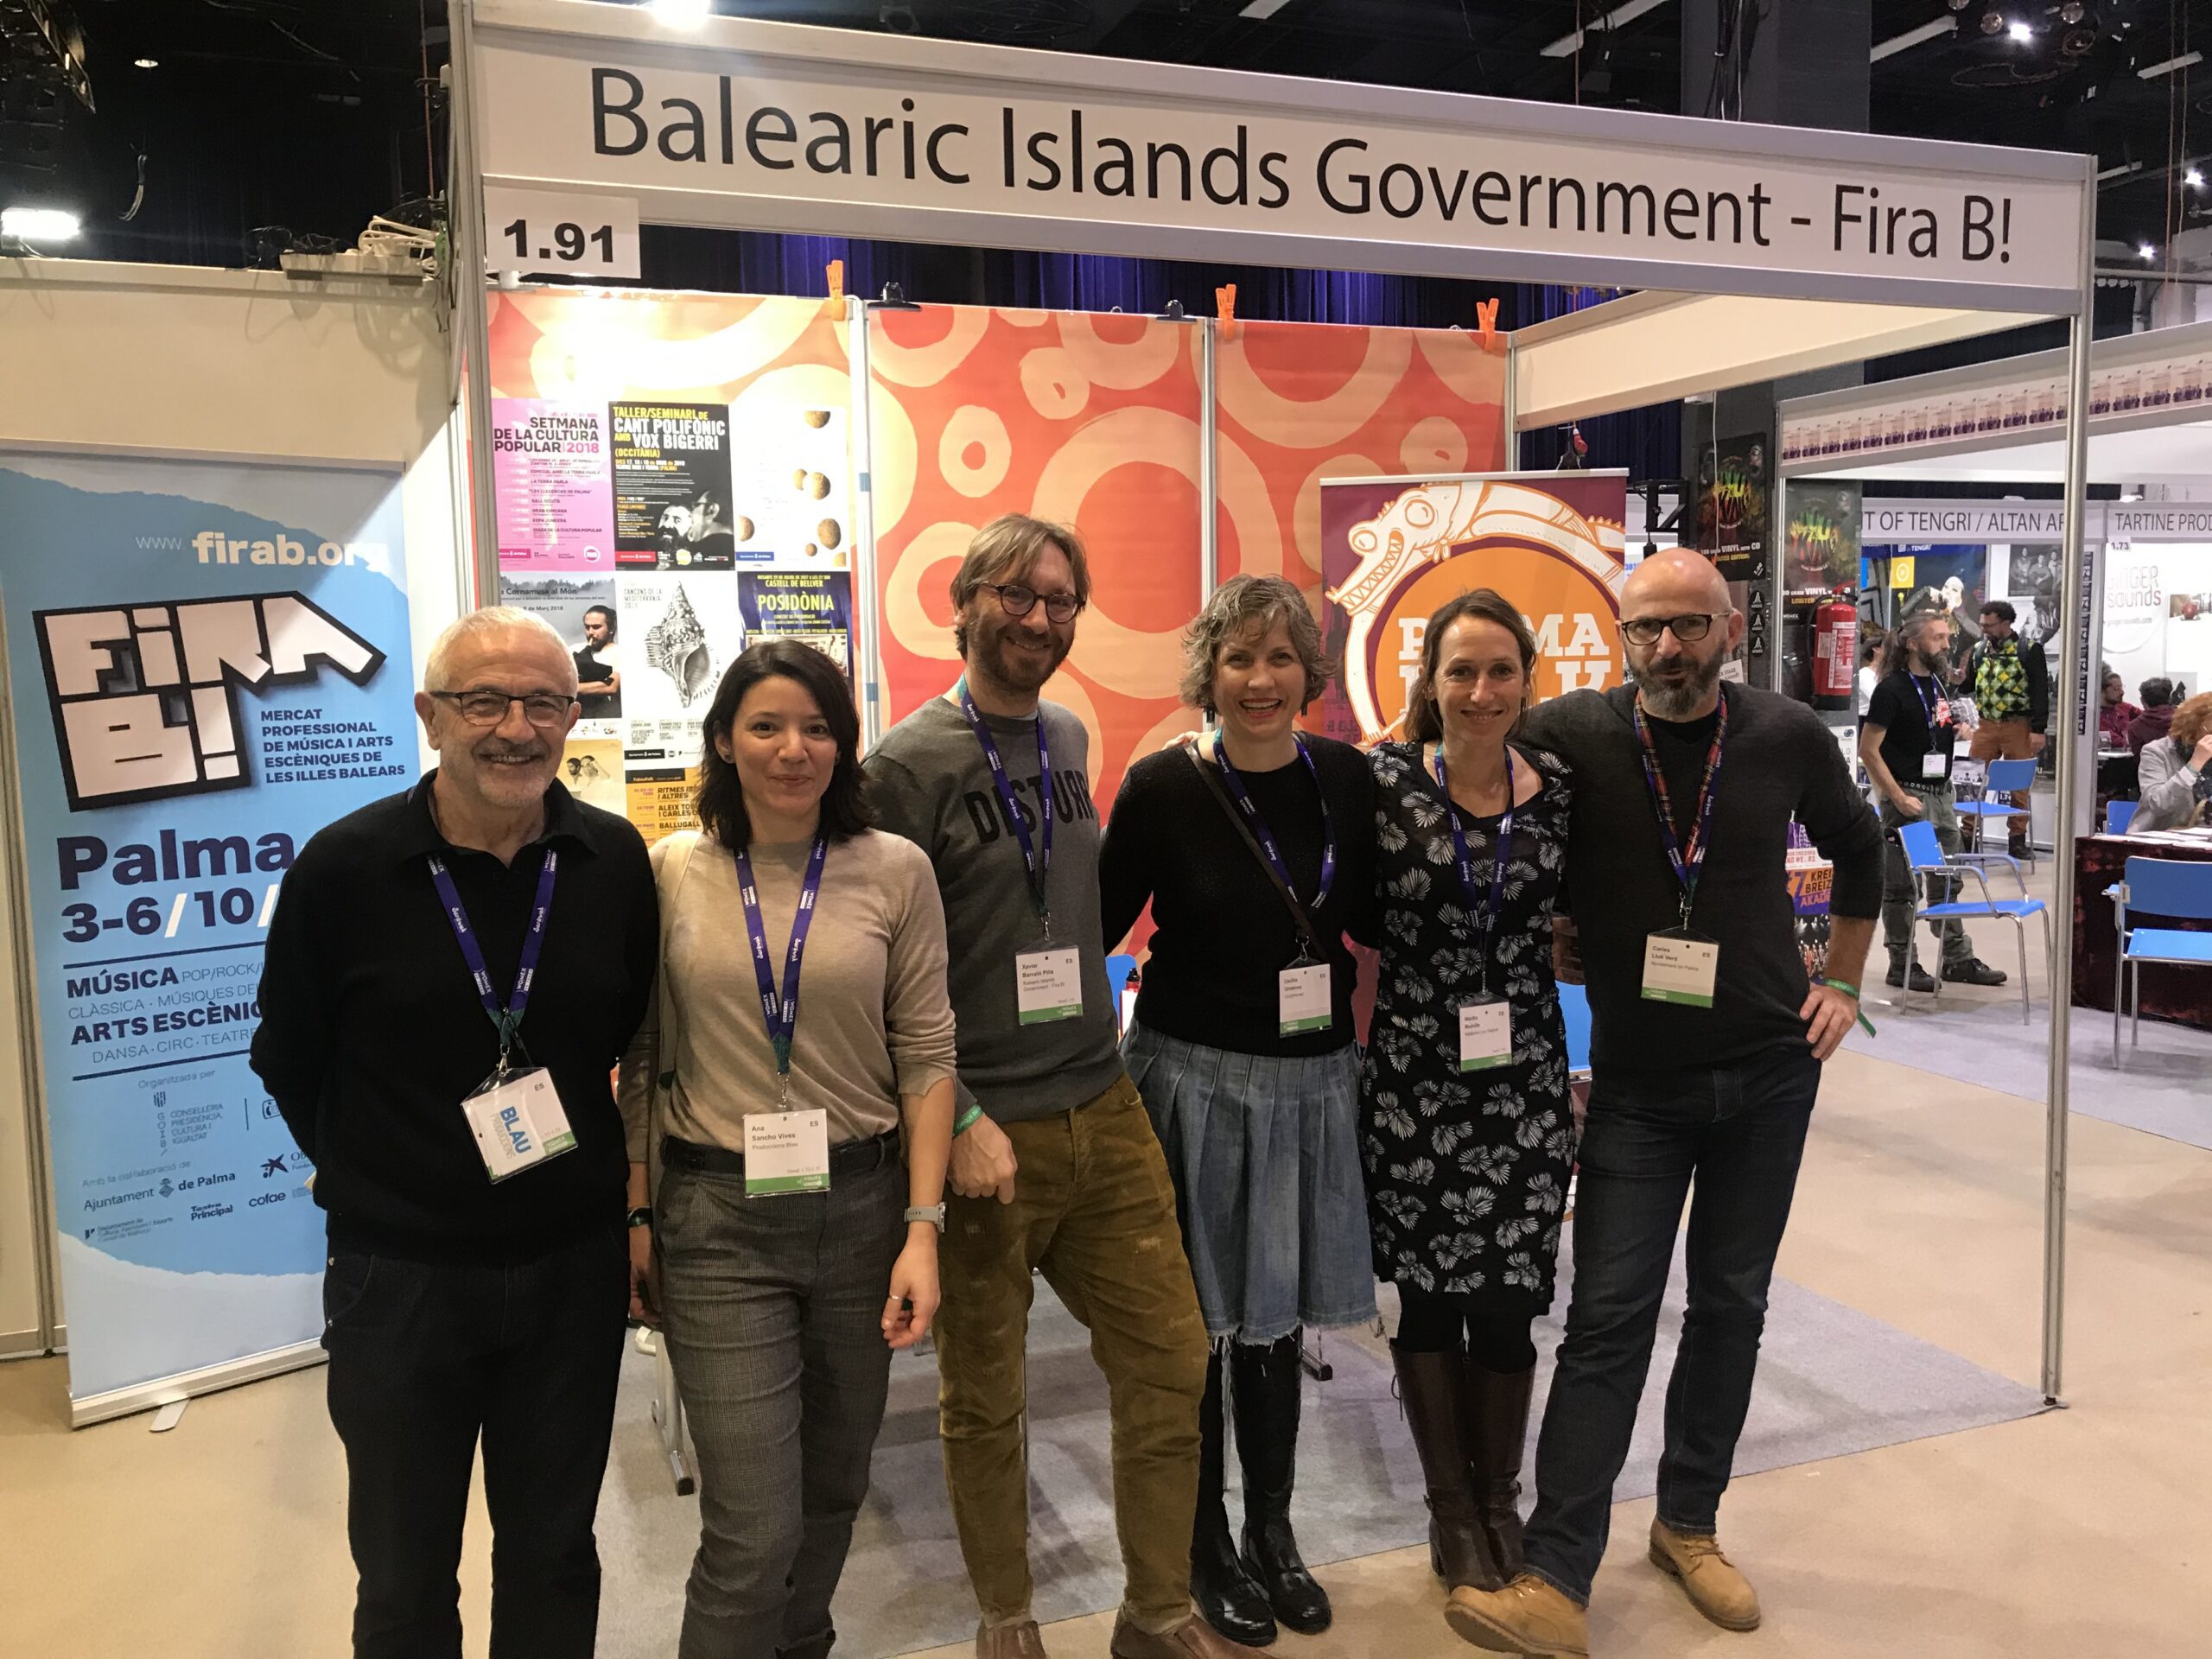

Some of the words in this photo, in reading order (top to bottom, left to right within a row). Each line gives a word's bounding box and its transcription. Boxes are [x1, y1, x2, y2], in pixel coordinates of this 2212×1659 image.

[591, 67, 970, 184] Balearic
[1003, 107, 1289, 208] Islands
[1317, 138, 1770, 247] Government
[1834, 183, 1938, 258] Fira
[1961, 194, 2012, 264] B!
[505, 219, 613, 263] 1.91
[613, 406, 696, 420] TALLER/SEMINARI
[698, 411, 709, 420] DE
[530, 416, 599, 429] SETMANA
[613, 417, 650, 433] CANT
[652, 416, 726, 436] POLIFÒNIC
[494, 429, 512, 440] DE
[515, 429, 533, 440] LA
[536, 430, 599, 442] CULTURA
[614, 433, 631, 442] AMB
[632, 433, 660, 448] VOX
[663, 434, 719, 450] BIGERRI
[495, 441, 562, 452] POPULAR
[566, 442, 600, 453] 2018
[1880, 511, 1904, 531] OF
[1908, 512, 1970, 531] TENGRI
[1987, 512, 2041, 531] ALTAN
[2115, 513, 2175, 531] TARTINE
[2178, 513, 2212, 531] PRO
[2111, 542, 2130, 550] 1.73
[758, 591, 835, 611] POSIDÒNIA
[261, 709, 322, 722] MERCAT
[262, 722, 377, 737] PROFESSIONAL
[264, 741, 283, 753] DE
[286, 737, 343, 751] MÚSICA
[347, 737, 353, 748] I
[355, 735, 393, 748] ARTS
[264, 750, 359, 768] ESCÈNIQUES
[363, 751, 382, 763] DE
[266, 771, 294, 784] LES
[296, 768, 337, 782] ILLES
[339, 765, 405, 779] BALEARS
[56, 829, 295, 891] Palma
[67, 965, 180, 998] MÚSICA
[181, 962, 264, 982] POP/ROCK/
[68, 1000, 145, 1020] CLÀSSICA
[157, 986, 234, 1008] MÚSIQUES
[71, 1016, 149, 1046] ARTS
[92, 1045, 149, 1064] DANSA
[157, 1037, 194, 1052] CIRC
[200, 1070, 216, 1080] per
[534, 1083, 545, 1091] ES
[499, 1106, 531, 1154] BLAU
[84, 1188, 155, 1212] Ajuntament
[178, 1179, 194, 1192] de
[197, 1173, 236, 1187] Palma
[249, 1192, 287, 1207] cofae
[190, 1205, 233, 1221] Principal
